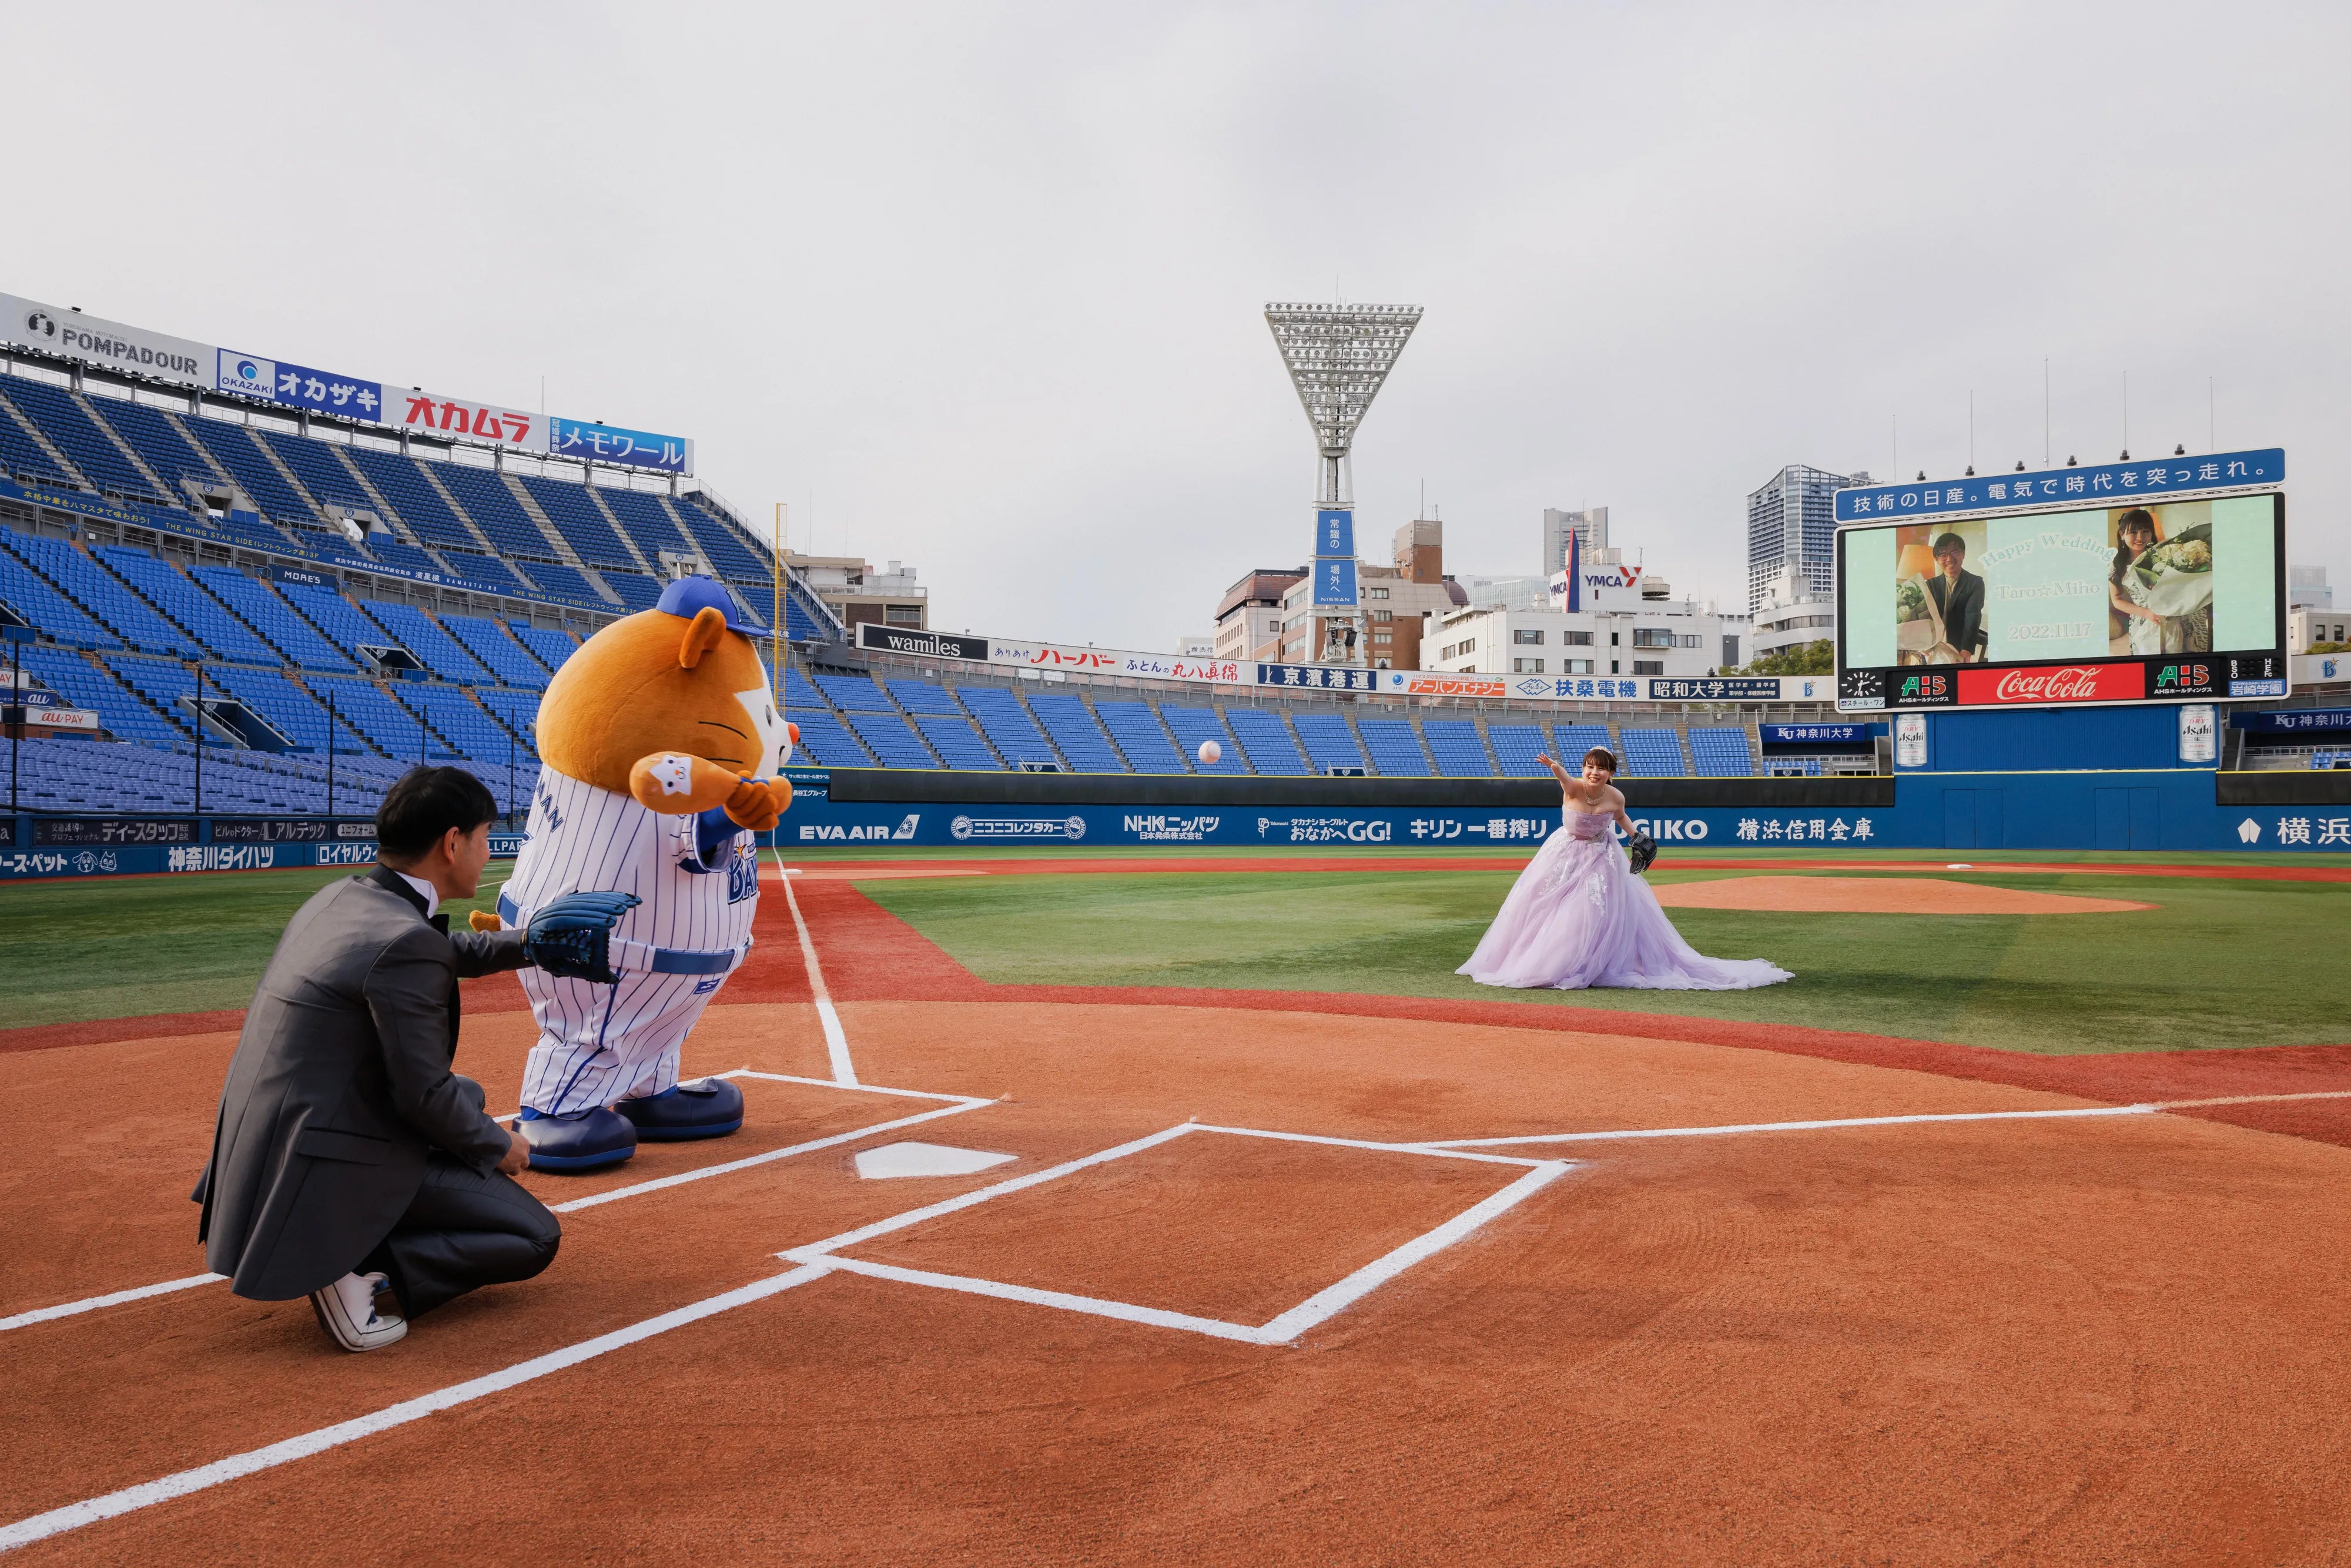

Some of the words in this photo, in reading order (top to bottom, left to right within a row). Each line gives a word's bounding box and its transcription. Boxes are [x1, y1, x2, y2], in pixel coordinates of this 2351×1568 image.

[63, 322, 93, 333] YOKOHAMA
[95, 330, 128, 342] MOTOMACHI
[62, 328, 198, 376] POMPADOUR
[222, 377, 273, 394] OKAZAKI
[278, 373, 379, 412] オカザキ
[406, 397, 530, 443] オカムラ
[551, 418, 560, 453] 冠婚葬祭
[561, 427, 683, 465] メモワール
[165, 522, 181, 531] THE
[185, 526, 206, 537] WING
[210, 532, 231, 542] STAR
[1329, 518, 1339, 549] 常識の
[1983, 541, 2033, 567] Happy
[2041, 534, 2115, 562] Wedding
[284, 571, 320, 584] MORE'S
[1330, 564, 1340, 592] 場外へ
[1585, 575, 1623, 588] YMCA
[513, 589, 525, 597] THE
[528, 592, 545, 601] WING
[548, 595, 565, 604] STAR
[1549, 581, 1567, 597] YMCA
[2009, 622, 2092, 639] 2022.11.17
[888, 635, 960, 656] wamiles
[994, 646, 1030, 659] ありあけ
[1030, 649, 1116, 667] ハーバー
[1283, 668, 1369, 689] 京濱港運
[1412, 680, 1505, 695] アーバンエナジー
[1997, 668, 2102, 700] Coca-Cola
[1555, 679, 1637, 698] 扶桑電機
[1654, 681, 1724, 698] 昭和大学
[2154, 686, 2213, 695] AHSホールディングス
[2231, 684, 2282, 696] 岩崎学園
[28, 694, 51, 705] au
[41, 712, 63, 722] au
[65, 714, 83, 724] PAY
[1796, 728, 1853, 739] 神奈川大学
[1899, 732, 1924, 742] Asahi
[2183, 724, 2212, 735] Asahi
[102, 822, 179, 842] ディースタッフ
[215, 825, 259, 838] ビルのドクター
[341, 825, 375, 835] ユニフォーム
[974, 822, 1063, 833] ニコニコレンタカー
[1140, 832, 1203, 840] 日本発条株式会社
[1736, 817, 1874, 840] 横浜信用金庫
[2277, 817, 2351, 845] 横浜
[0, 853, 68, 873] ース・ペット
[169, 845, 274, 872] 神奈川ダイハツ
